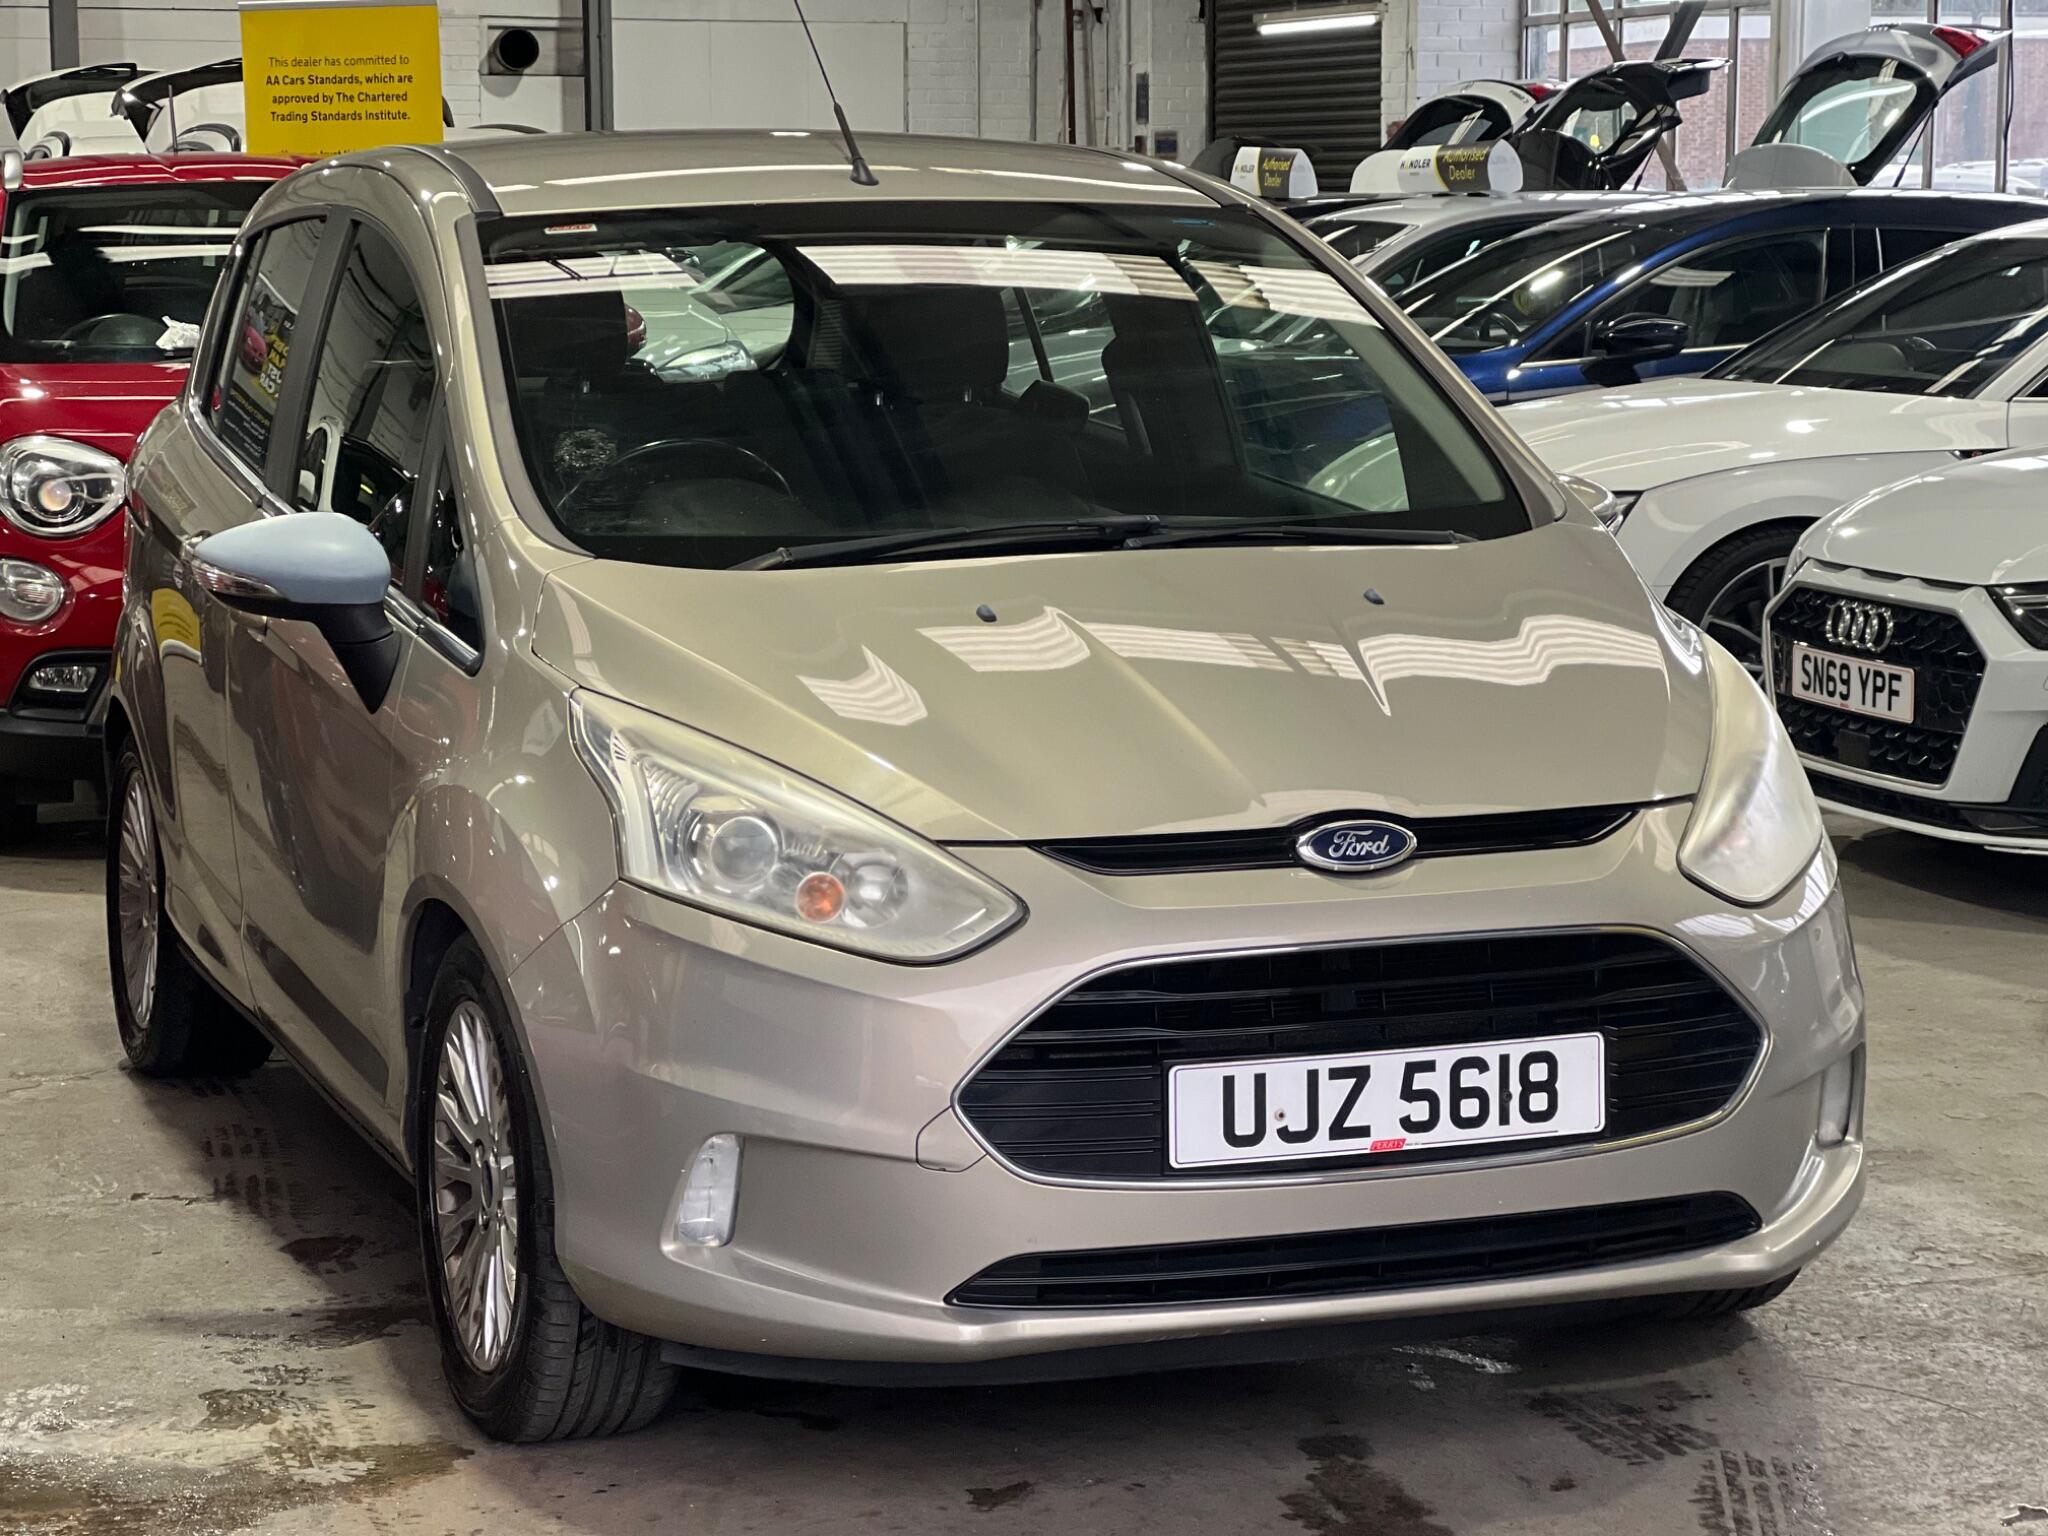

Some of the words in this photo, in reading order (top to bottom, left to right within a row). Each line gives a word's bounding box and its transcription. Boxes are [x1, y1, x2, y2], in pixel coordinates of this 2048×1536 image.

[268, 57, 289, 68] This
[291, 56, 322, 67] dealer
[324, 56, 341, 67] has
[343, 55, 397, 66] committed
[399, 55, 410, 65] to
[266, 75, 280, 86] AA
[282, 75, 305, 86] Cars
[307, 74, 363, 86] Standards,
[365, 73, 395, 84] which
[397, 74, 414, 84] are
[272, 93, 320, 105] approved
[322, 93, 334, 105] by
[336, 92, 355, 103] The
[357, 91, 408, 103] Chartered
[270, 111, 309, 124] Trading
[311, 110, 363, 122] Standards
[365, 110, 411, 121] Institute.
[1449, 165, 1475, 180] Dealer
[1801, 653, 1851, 702] SN69
[1858, 666, 1903, 712] YPF
[1328, 829, 1391, 858] Ford
[1222, 1065, 1372, 1149] UJZ
[1399, 1050, 1559, 1134] 5618
